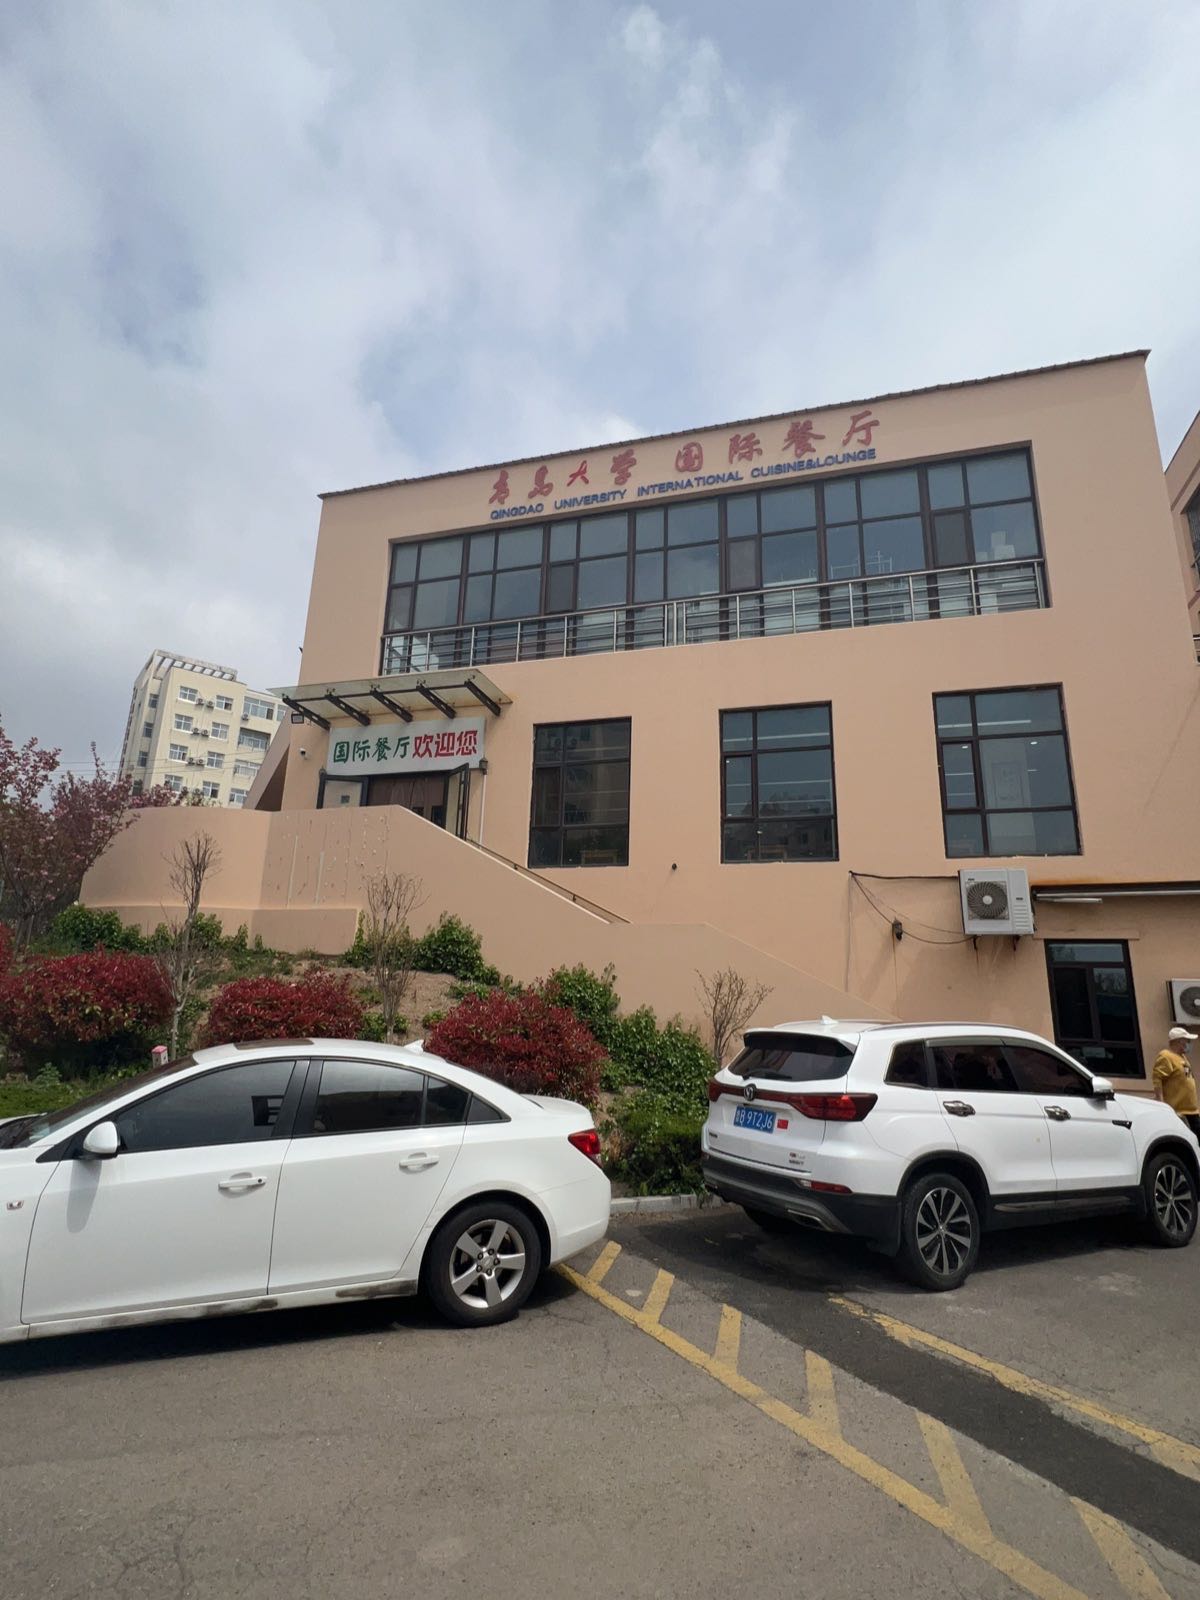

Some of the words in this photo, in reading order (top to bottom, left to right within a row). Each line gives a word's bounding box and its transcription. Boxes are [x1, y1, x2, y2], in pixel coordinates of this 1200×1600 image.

[490, 503, 544, 520] QINGDAO
[554, 489, 627, 510] UNIVERSITY
[637, 471, 743, 498] INTERNATIONAL
[751, 448, 876, 479] CUISINE&LOUNGE
